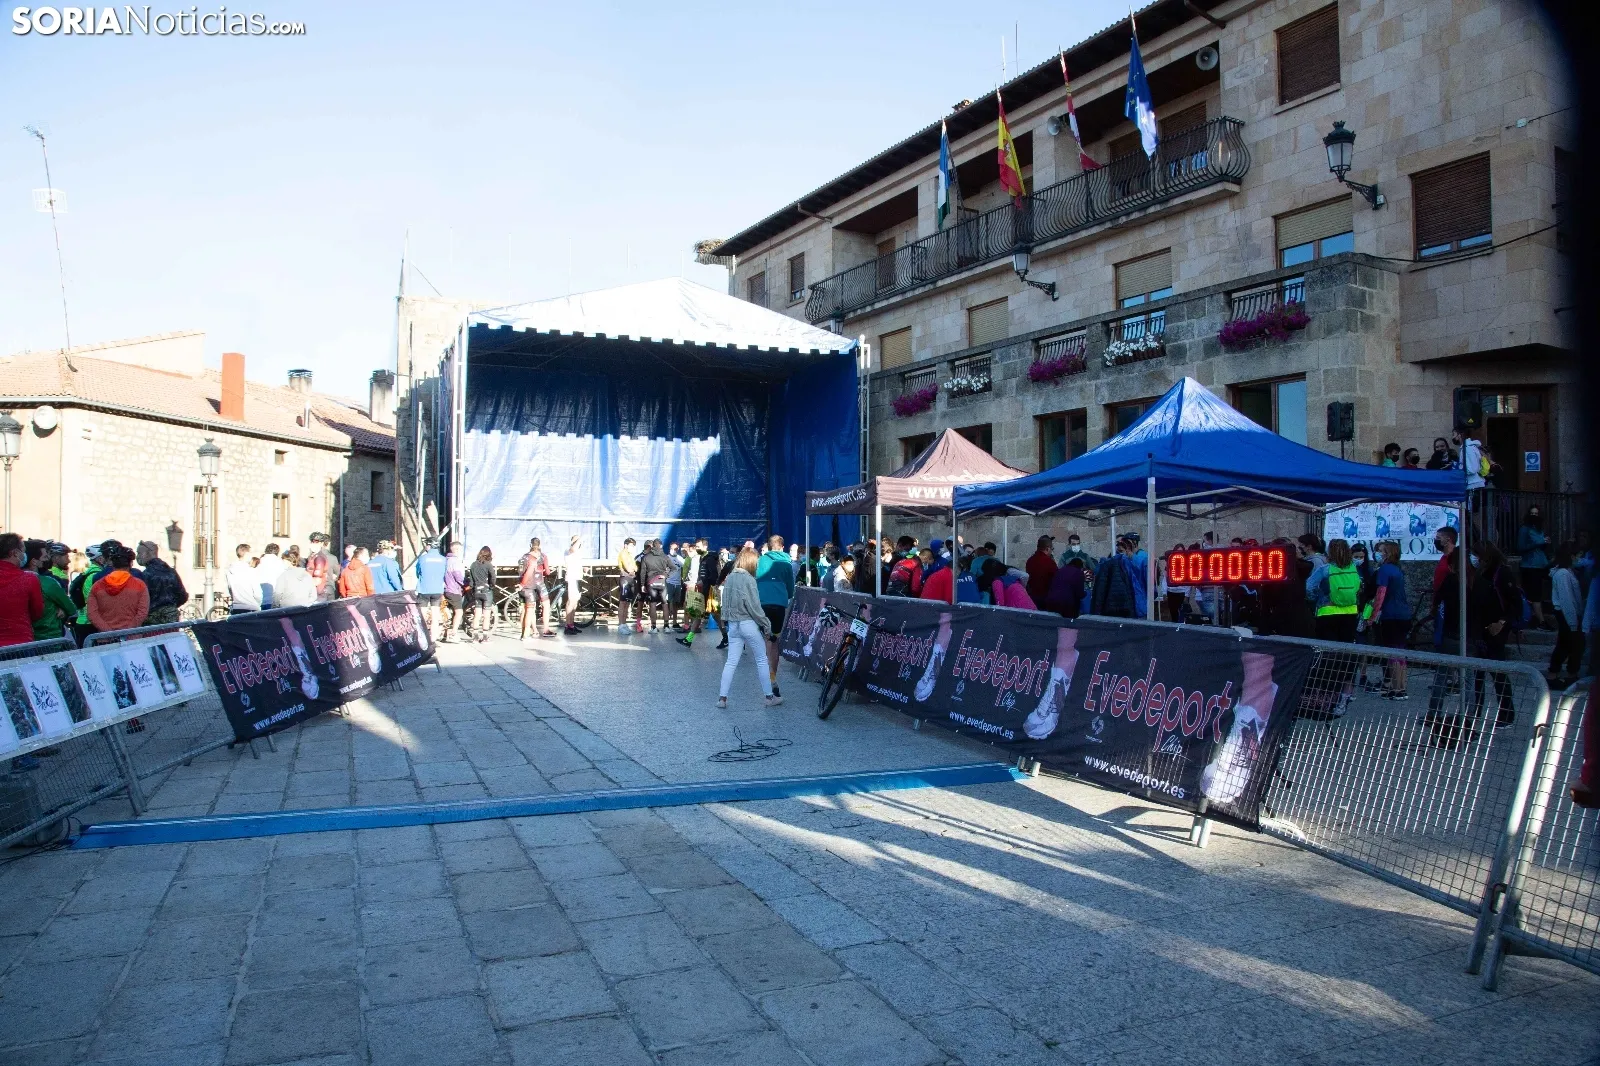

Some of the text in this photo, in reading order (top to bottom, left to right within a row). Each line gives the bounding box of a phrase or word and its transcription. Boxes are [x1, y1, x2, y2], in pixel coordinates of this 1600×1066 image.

[306, 620, 367, 665] Evedeport
[212, 637, 299, 695] Evedeport
[952, 629, 1050, 707] Evedeport
[253, 703, 305, 731] www.evedeport.es
[1084, 650, 1233, 753] Evedeport
[949, 710, 1015, 740] www.evedeport.es
[1158, 734, 1188, 761] Chip
[1084, 754, 1186, 799] www.evedeport.es
